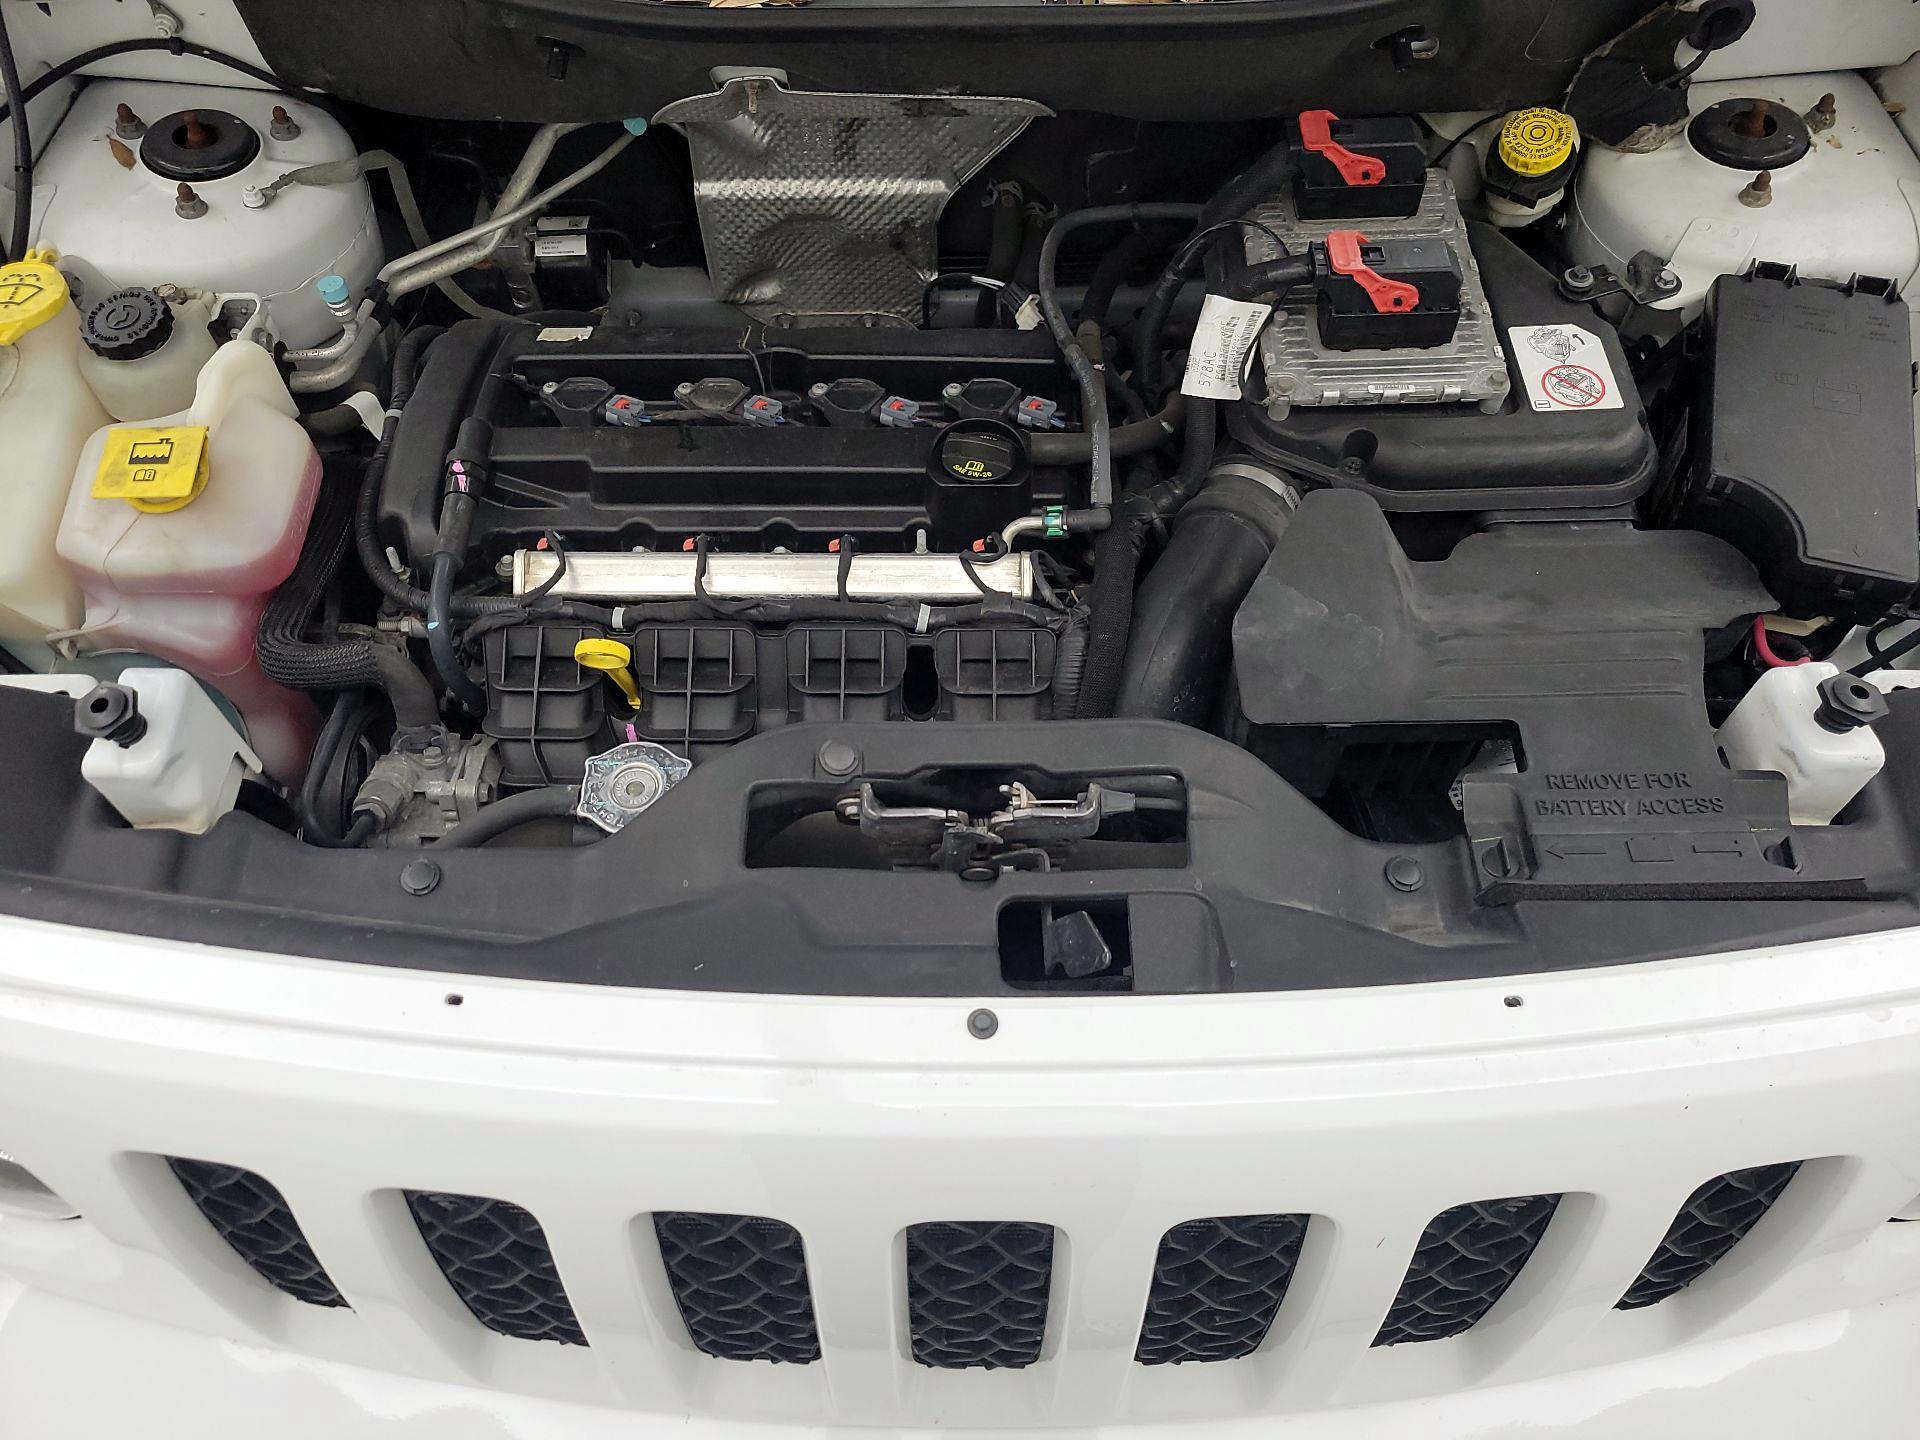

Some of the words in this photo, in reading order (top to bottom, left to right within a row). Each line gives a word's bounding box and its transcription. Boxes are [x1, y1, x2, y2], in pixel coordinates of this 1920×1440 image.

[1198, 351, 1217, 387] 578AC
[953, 464, 967, 474] SAE
[1545, 773, 1641, 790] REMOVE
[1645, 772, 1692, 789] FOR
[1535, 799, 1629, 816] BATTERY
[1637, 797, 1725, 816] ACCESS
